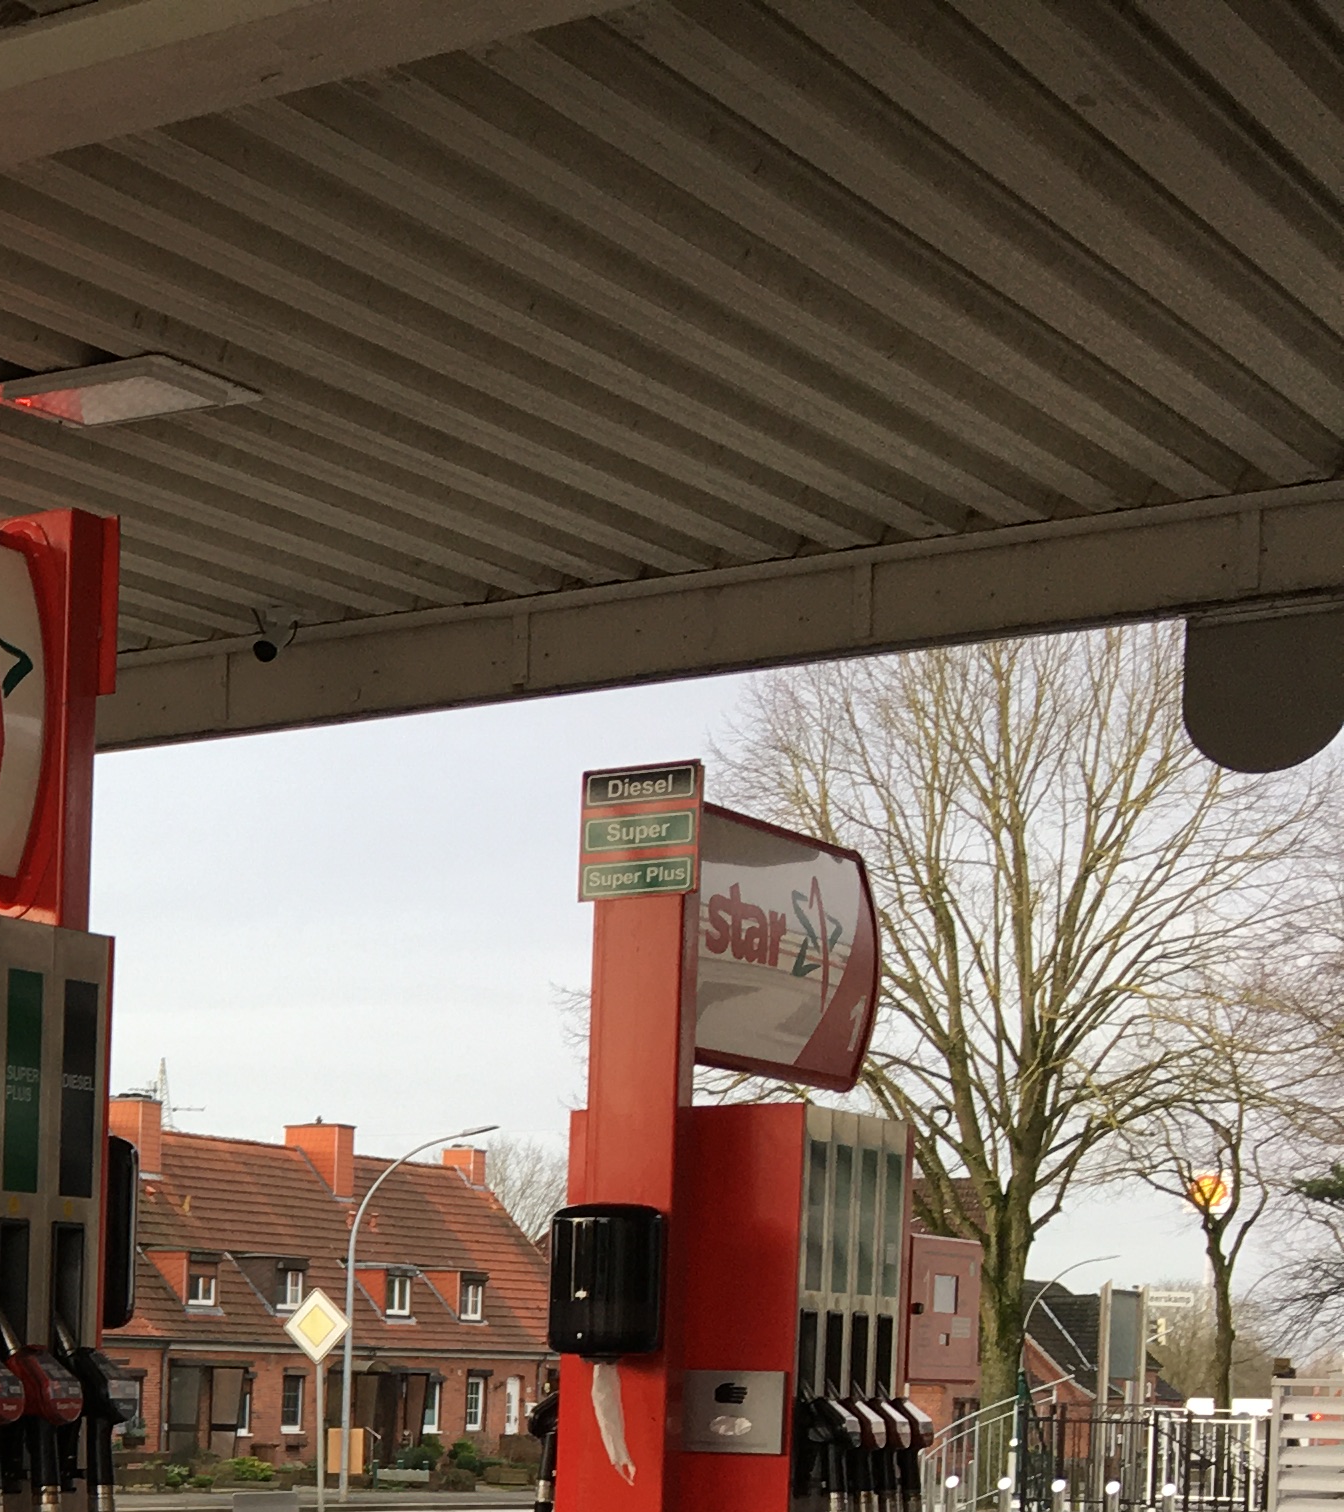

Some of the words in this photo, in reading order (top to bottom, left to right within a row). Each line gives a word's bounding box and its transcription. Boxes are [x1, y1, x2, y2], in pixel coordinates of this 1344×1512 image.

[607, 774, 673, 799] Diesel
[606, 822, 670, 844] Super
[588, 868, 641, 889] Super
[646, 865, 686, 882] Plus
[705, 882, 787, 967] star
[849, 995, 867, 1052] 1
[7, 1065, 40, 1083] SUPER
[62, 1073, 95, 1092] DIESEL
[6, 1085, 32, 1102] PLUS
